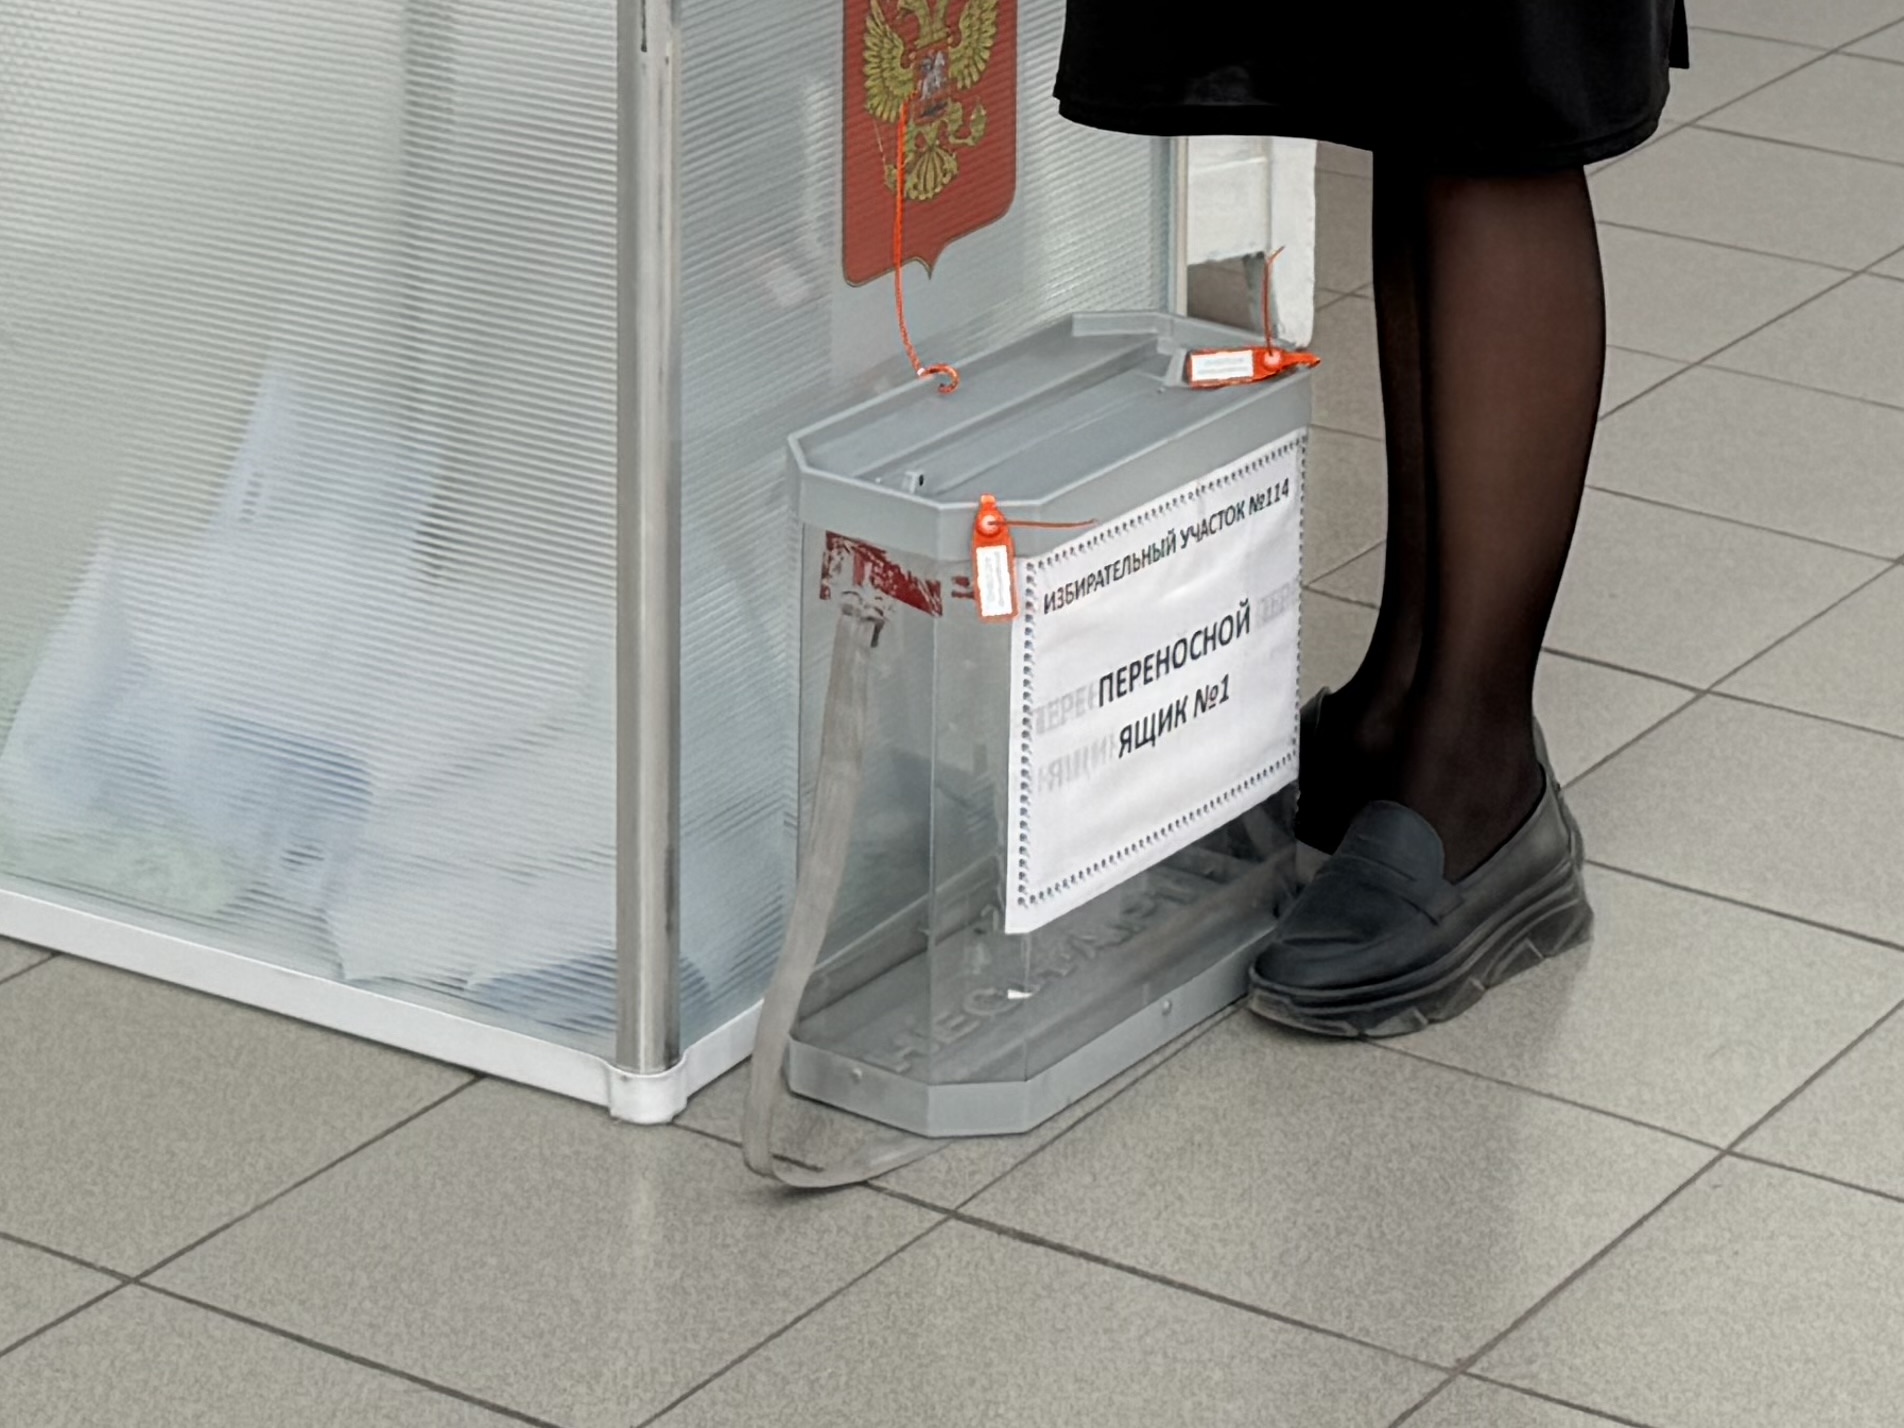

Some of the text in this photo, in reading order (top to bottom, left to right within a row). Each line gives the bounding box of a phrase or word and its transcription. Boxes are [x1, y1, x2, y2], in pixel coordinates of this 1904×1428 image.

[1043, 478, 1290, 615] ИЗБИРАТЕЛЬНЫЙ УЧАСТОК №114
[1098, 598, 1251, 708] ПЕРЕНОСНОЙ
[1118, 673, 1230, 759] ЯЩИК №1
